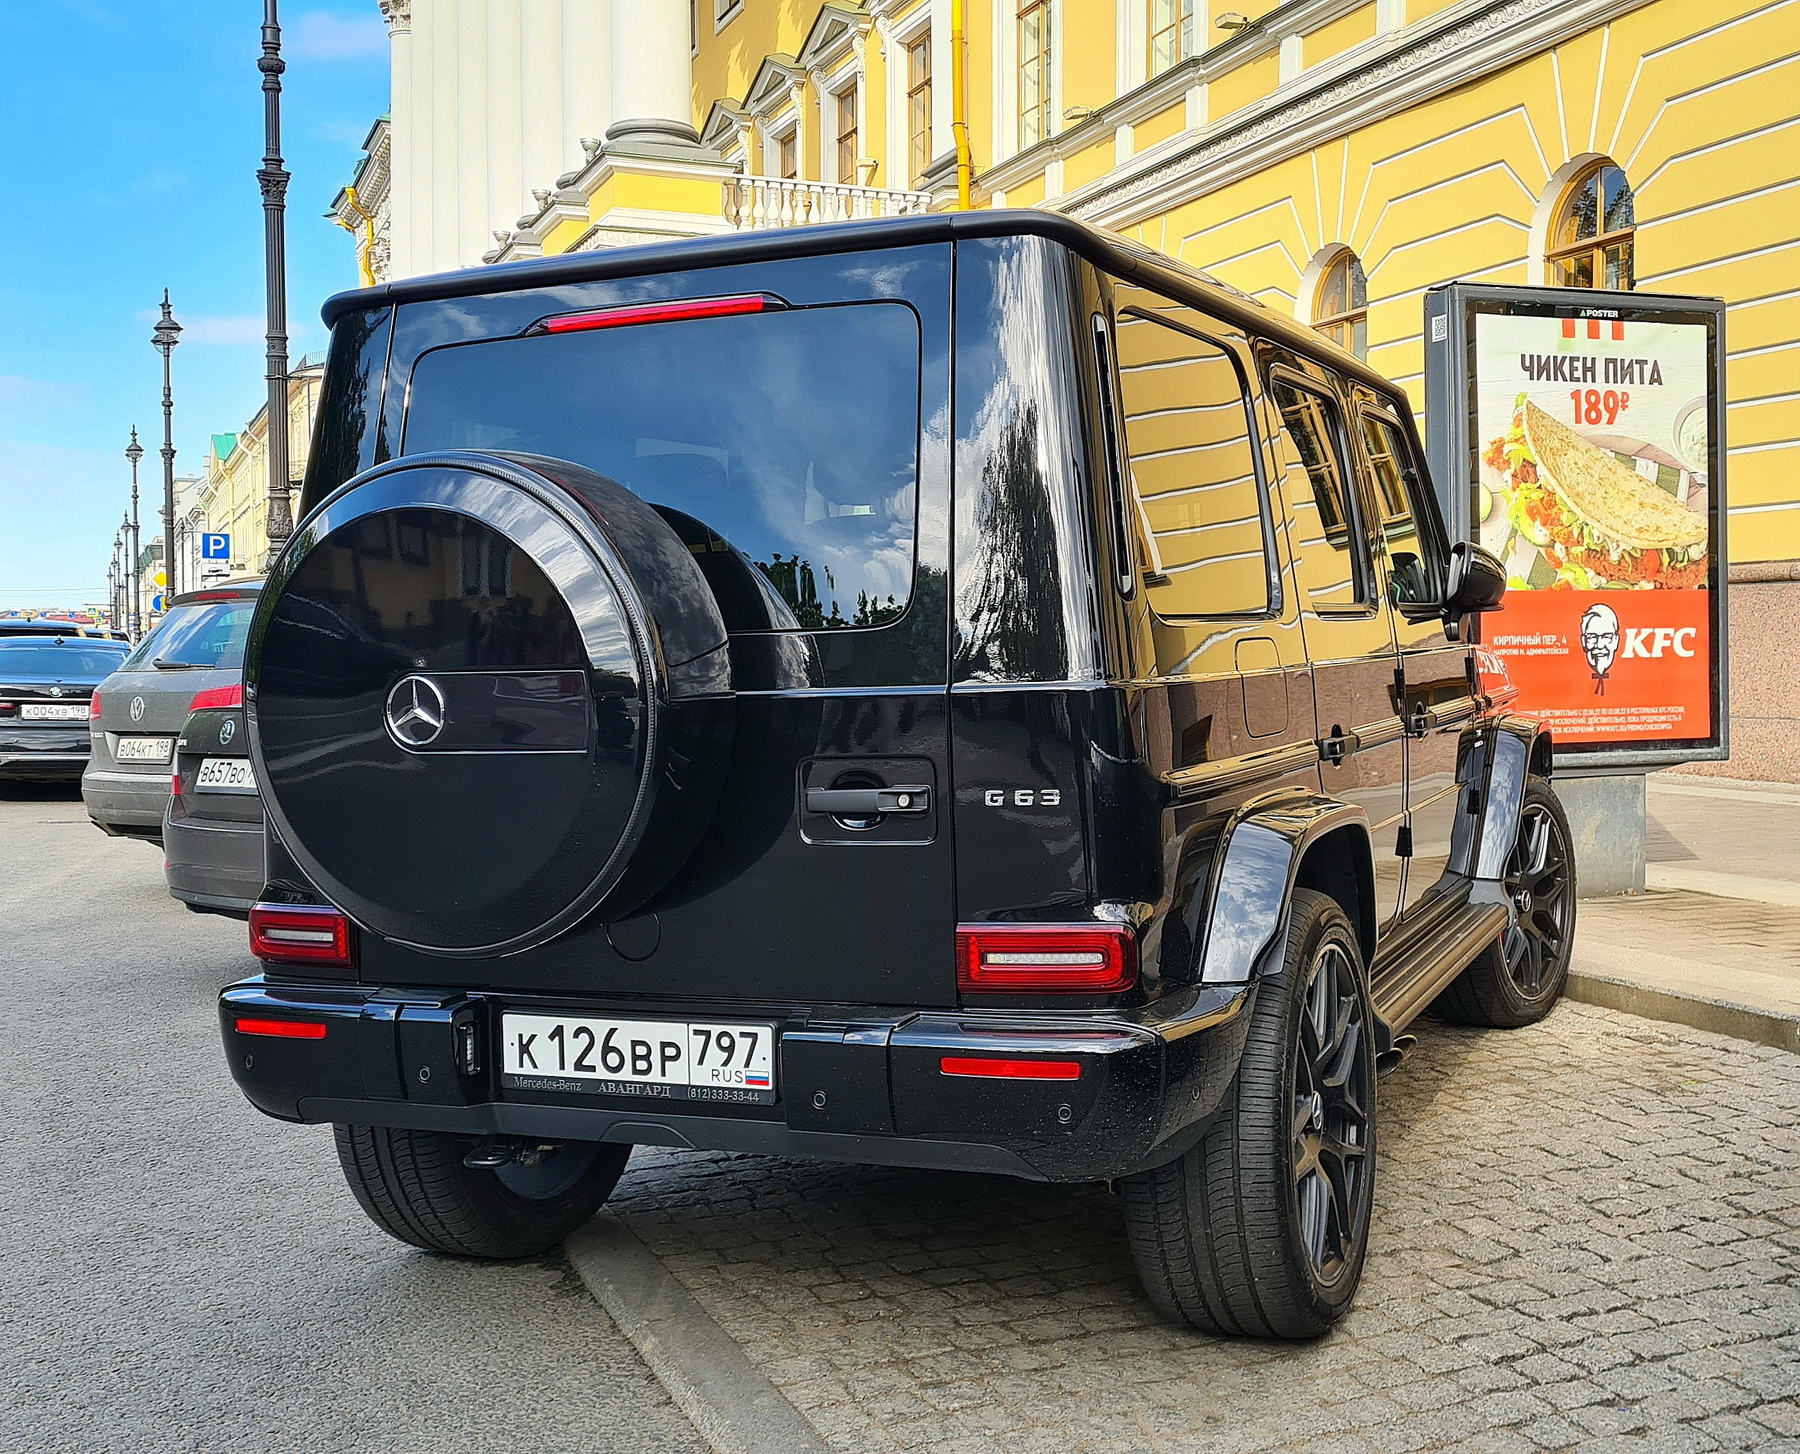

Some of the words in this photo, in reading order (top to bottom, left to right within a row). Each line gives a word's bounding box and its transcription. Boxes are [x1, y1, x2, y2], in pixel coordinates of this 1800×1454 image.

[1520, 354, 1597, 383] ЧИКЕН
[1604, 358, 1663, 386] ПИТА
[1493, 632, 1541, 646] КИРПИЧНЫЙ
[1562, 635, 1567, 645] 4
[1621, 627, 1697, 659] KFC
[70, 706, 86, 714] 198
[155, 739, 170, 753] 198
[985, 789, 1004, 806] G
[1014, 789, 1061, 806] 63
[692, 1029, 759, 1069] 797
[514, 1076, 582, 1092] Mercedes-Benz
[711, 1069, 744, 1084] RUS
[597, 1082, 671, 1098] АВАНГАРД
[687, 1088, 760, 1102] (812)333-33-44
